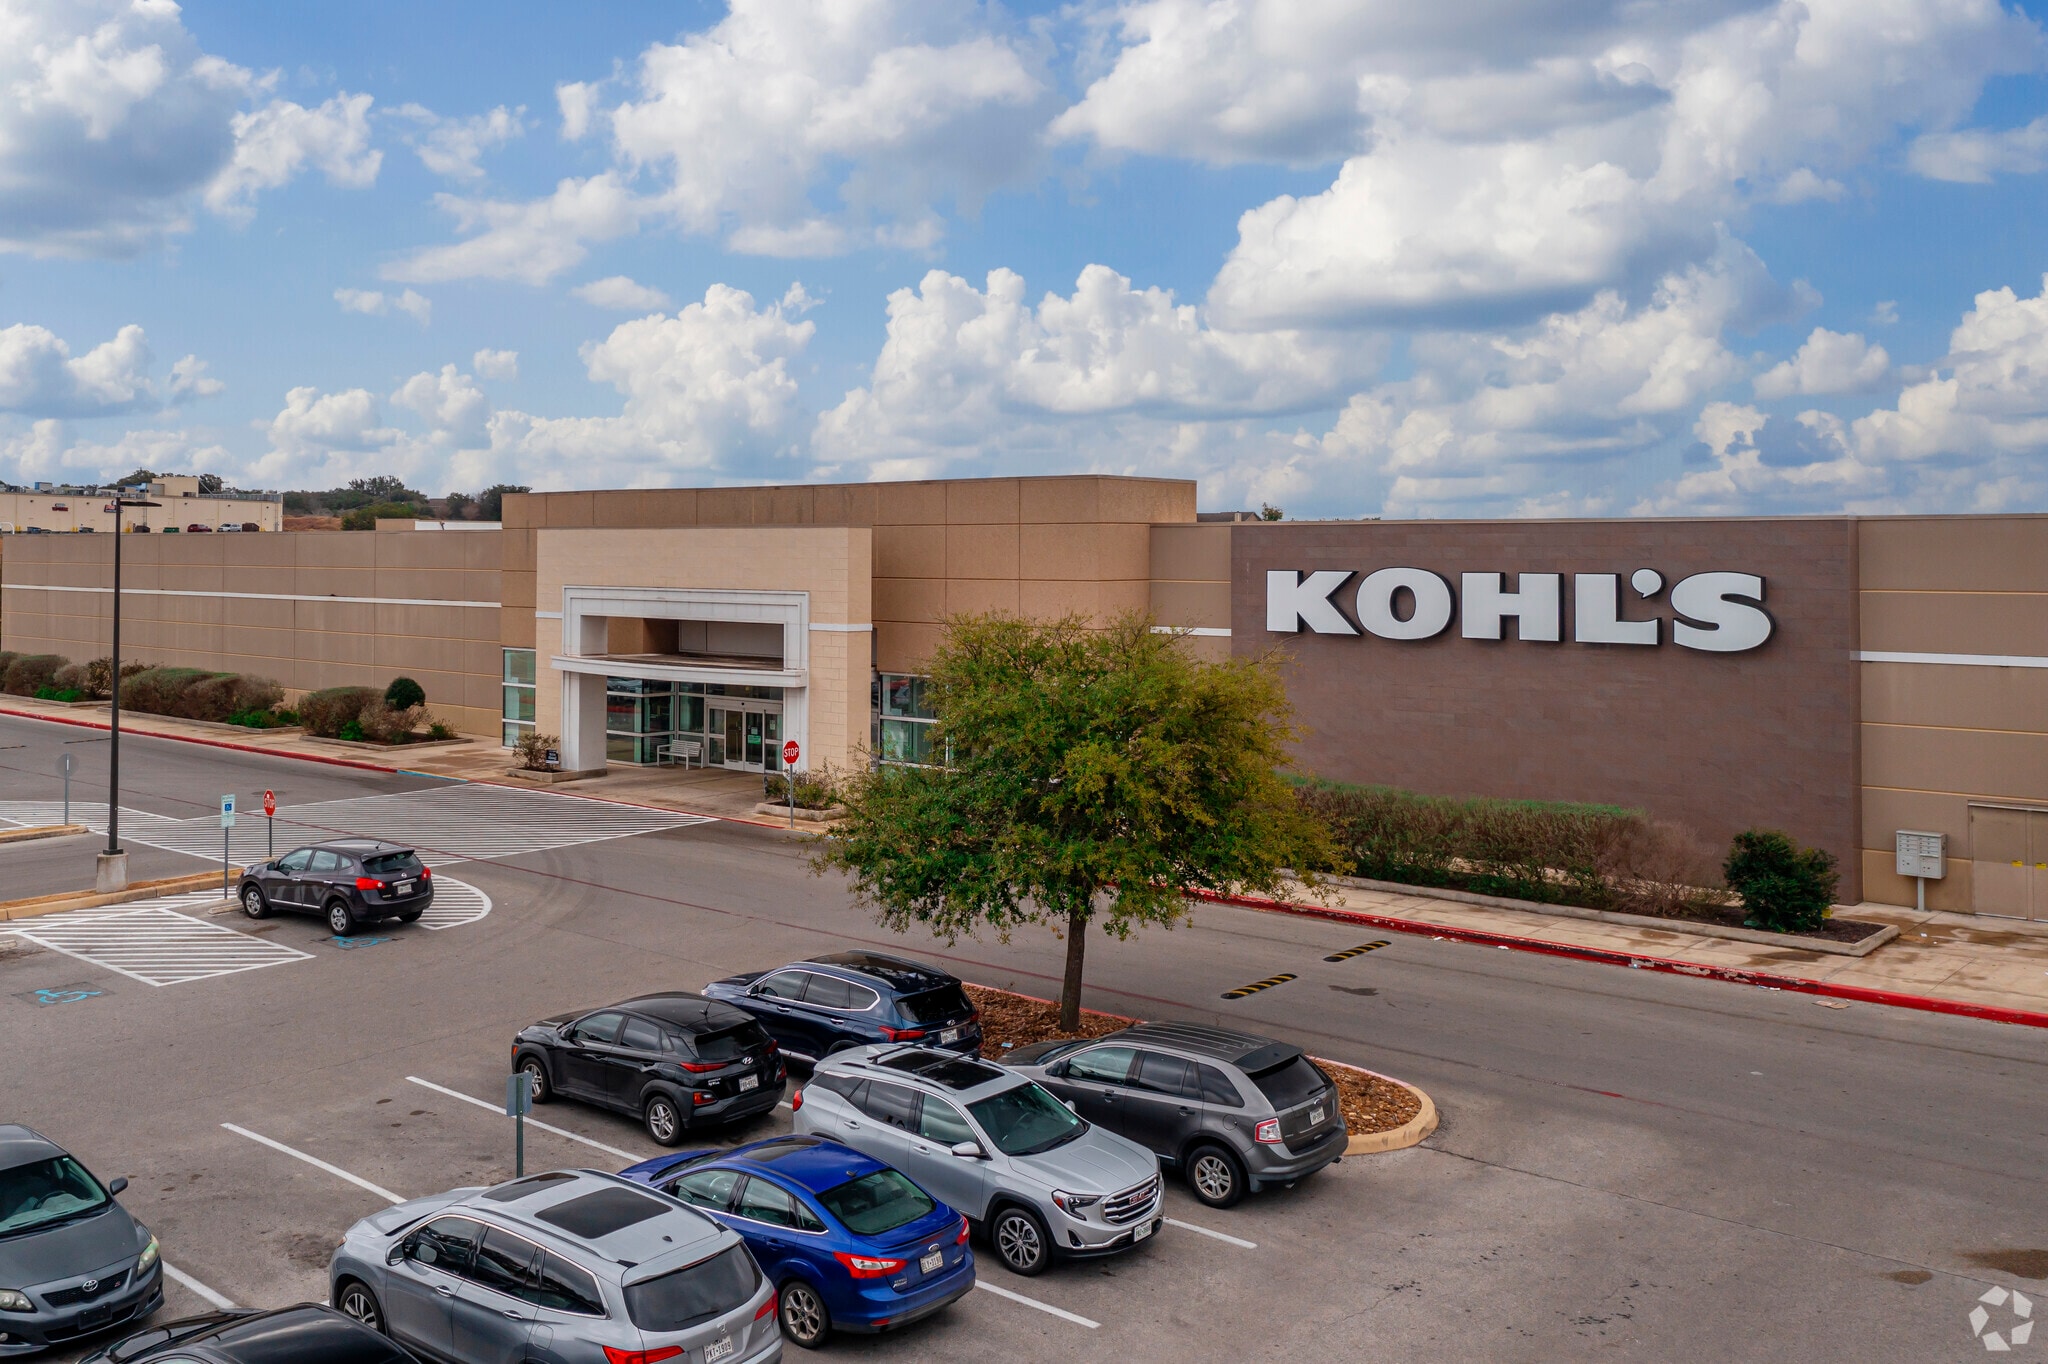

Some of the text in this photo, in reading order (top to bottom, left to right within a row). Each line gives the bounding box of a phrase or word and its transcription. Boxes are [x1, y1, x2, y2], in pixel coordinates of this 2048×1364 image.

[1266, 566, 1776, 653] KOHL'S
[783, 747, 799, 758] STOP
[264, 797, 275, 809] STOP
